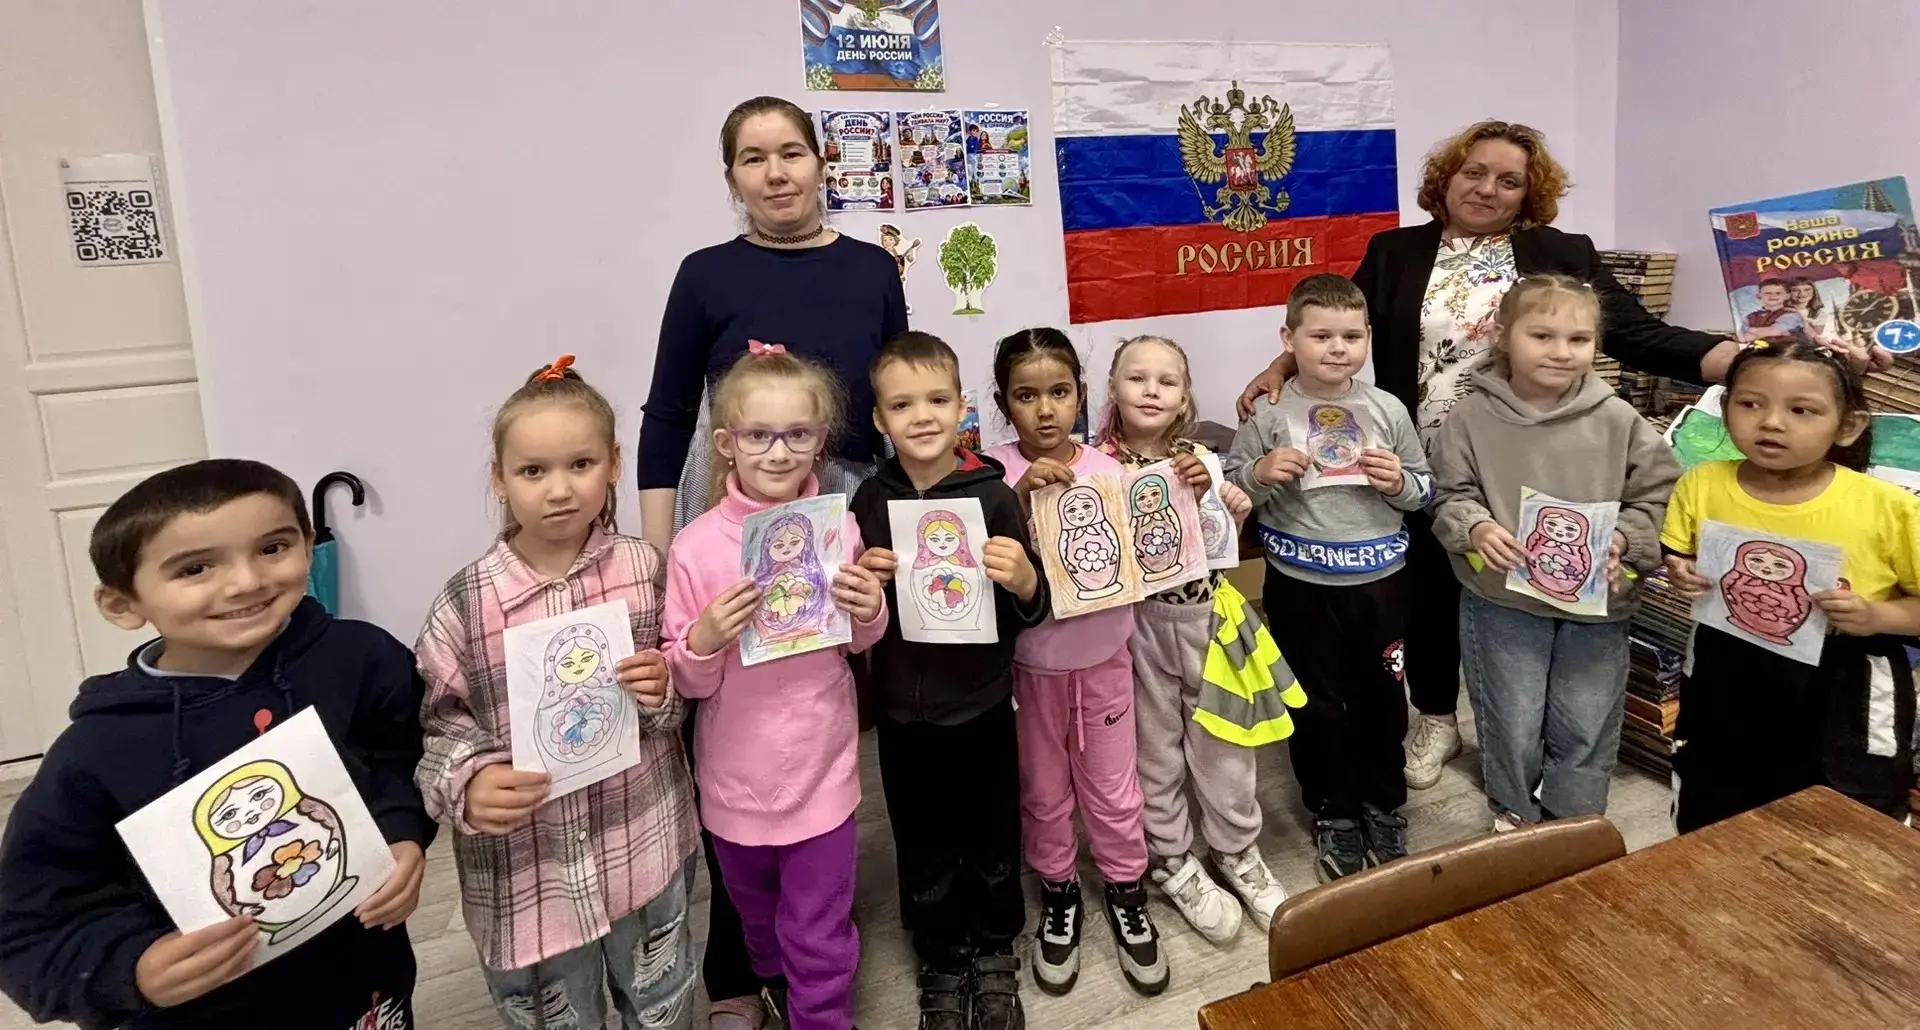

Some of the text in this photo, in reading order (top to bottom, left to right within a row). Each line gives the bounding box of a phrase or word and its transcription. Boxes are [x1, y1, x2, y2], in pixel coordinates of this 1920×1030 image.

[836, 34, 911, 49] 12 ИЮНЯ
[836, 51, 912, 61] ДЕНЬ РОССИИ
[845, 119, 868, 127] ДЕНЬ
[978, 113, 1013, 124] РОССИЯ
[839, 127, 876, 136] РОССИИ?
[1784, 215, 1840, 231] Наша
[1767, 227, 1859, 252] родина
[1175, 237, 1315, 276] РОССИЯ
[1756, 241, 1885, 273] РОССИЯ
[1885, 328, 1916, 345] 7+
[1391, 649, 1404, 672] 3
